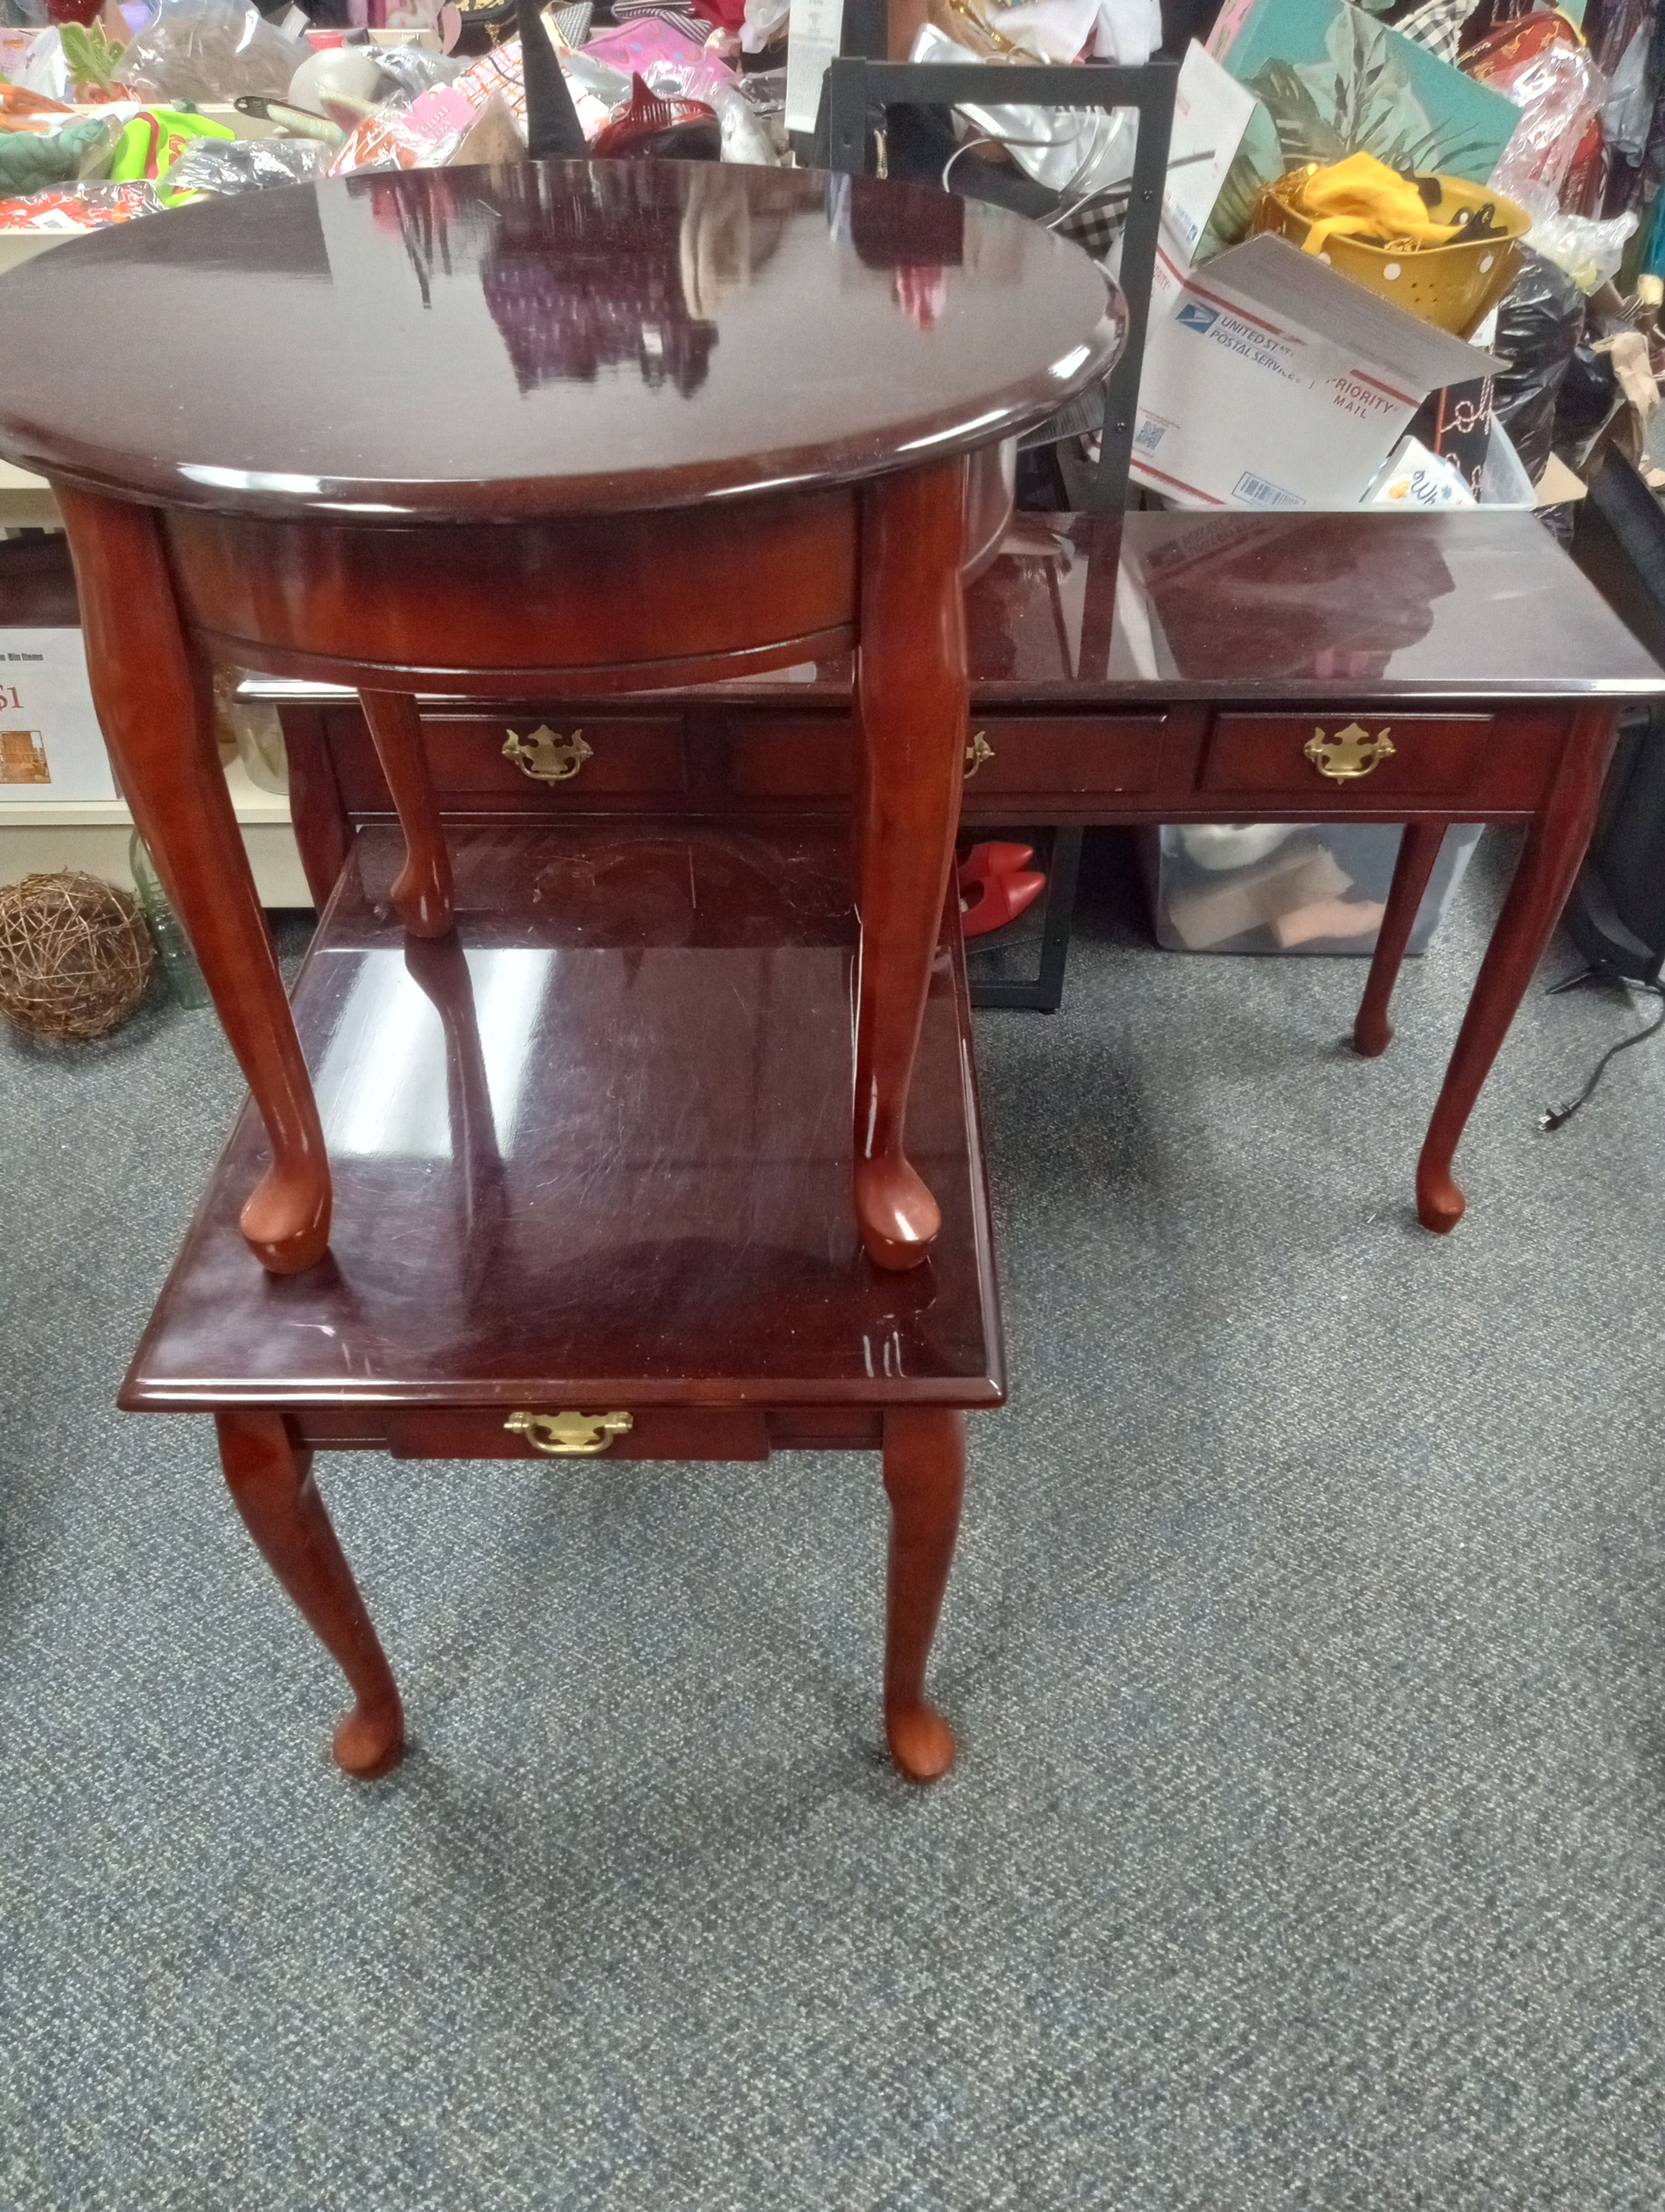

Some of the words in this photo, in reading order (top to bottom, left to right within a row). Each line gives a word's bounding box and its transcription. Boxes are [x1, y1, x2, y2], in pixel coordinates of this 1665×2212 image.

[1209, 330, 1252, 358] POSTAL
[1221, 316, 1265, 344] UNITED
[1333, 395, 1367, 419] MAIL
